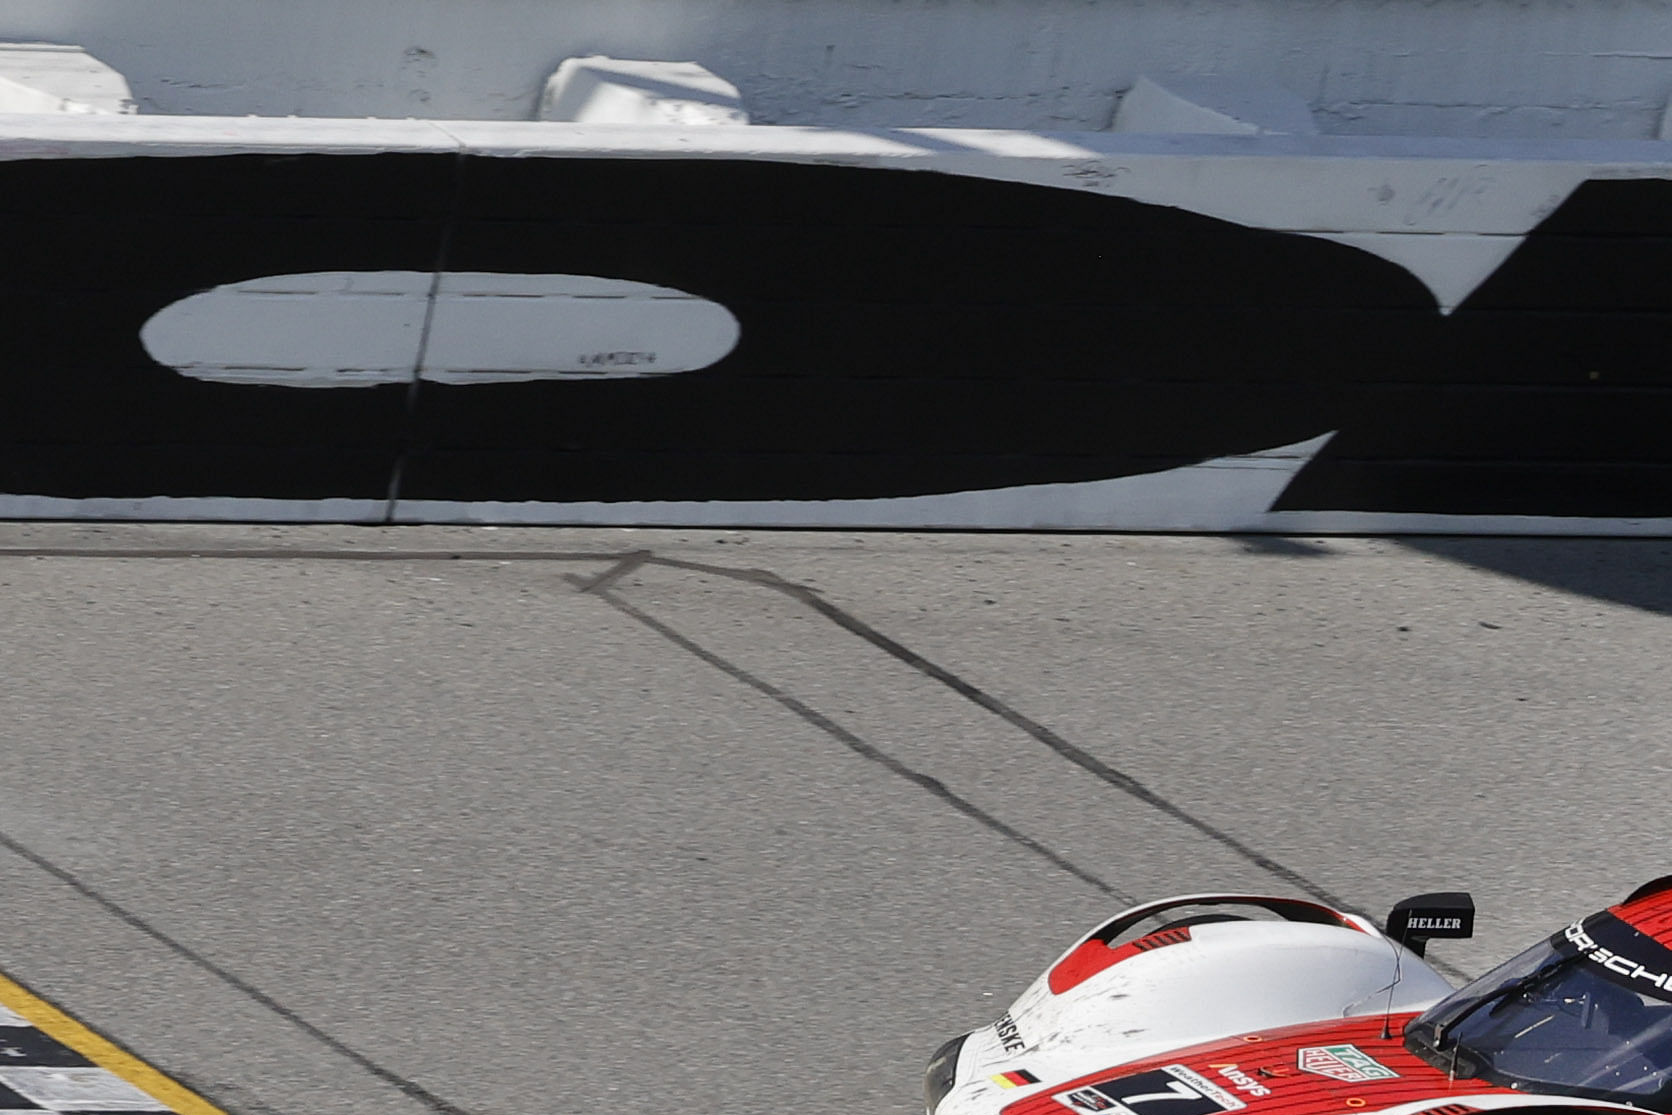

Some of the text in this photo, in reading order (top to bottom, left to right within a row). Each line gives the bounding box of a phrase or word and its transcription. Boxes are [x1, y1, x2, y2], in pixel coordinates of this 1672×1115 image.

[1407, 917, 1462, 930] HELLER
[1305, 1048, 1363, 1081] HEUER
[1334, 1047, 1391, 1078] TAG
[1121, 1080, 1202, 1104] 7
[1207, 1063, 1272, 1097] Ansys
